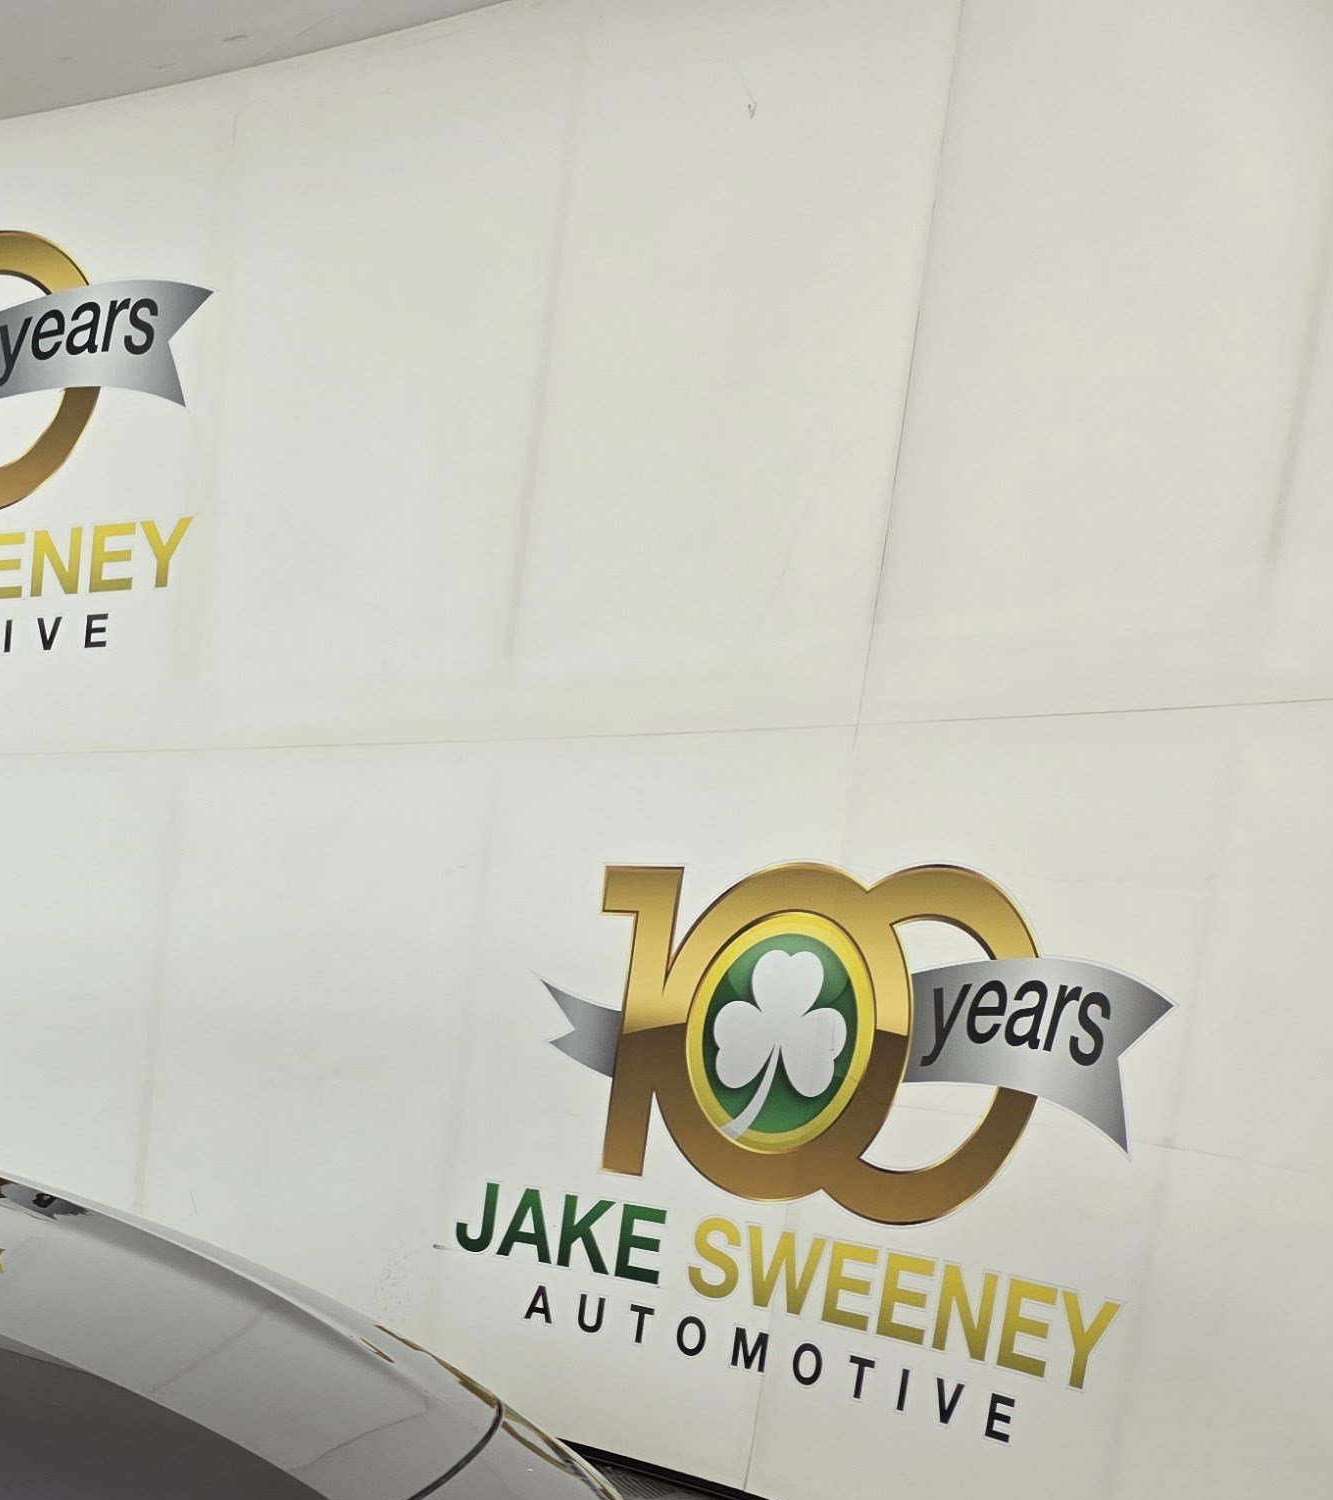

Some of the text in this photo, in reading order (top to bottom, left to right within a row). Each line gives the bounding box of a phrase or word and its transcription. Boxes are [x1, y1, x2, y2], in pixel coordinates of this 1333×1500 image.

[602, 862, 1112, 1225] 100 years
[455, 1182, 1123, 1391] JAKE SWEENEY
[525, 1285, 1016, 1444] AUTOMOTIVE
